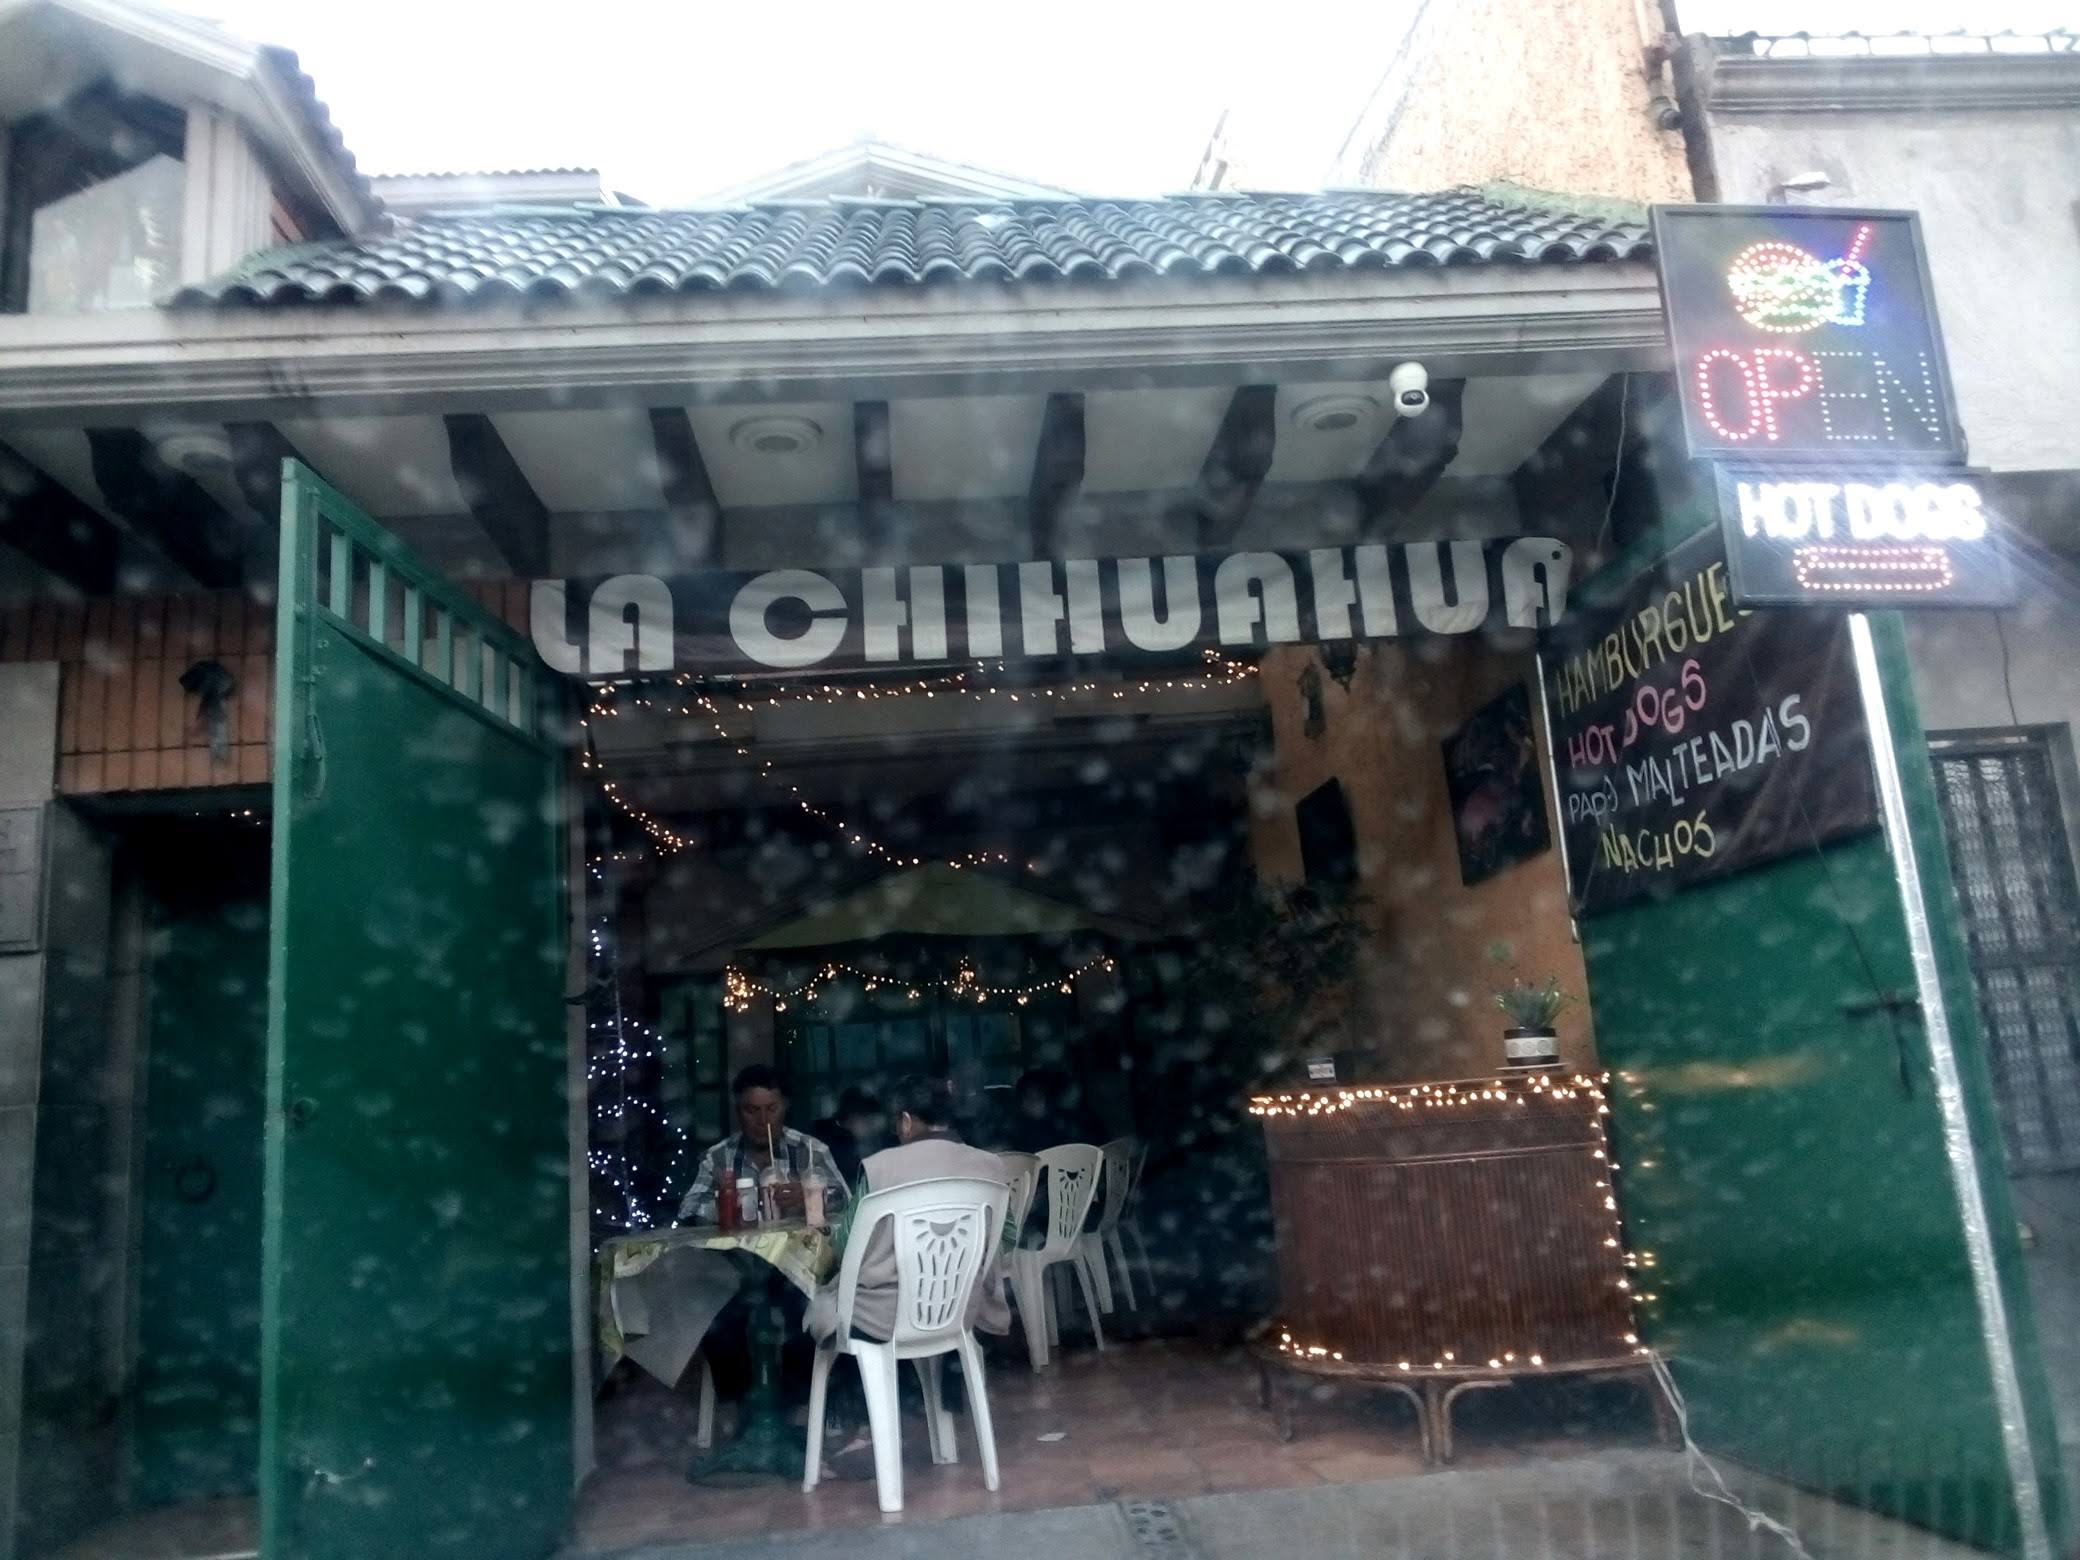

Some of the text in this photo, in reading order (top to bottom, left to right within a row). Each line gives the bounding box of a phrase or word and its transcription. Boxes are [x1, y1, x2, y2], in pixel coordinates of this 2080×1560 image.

[1697, 347, 1941, 441] OPEN
[1737, 481, 1987, 541] HOT DOGS
[530, 536, 1572, 674] LA CHIHUAHUA
[1556, 562, 1752, 717] HAMBURGUE
[1568, 725, 1617, 769] HOT
[1626, 694, 1811, 807] MALTEADAS
[1602, 809, 1717, 874] NACHOS
